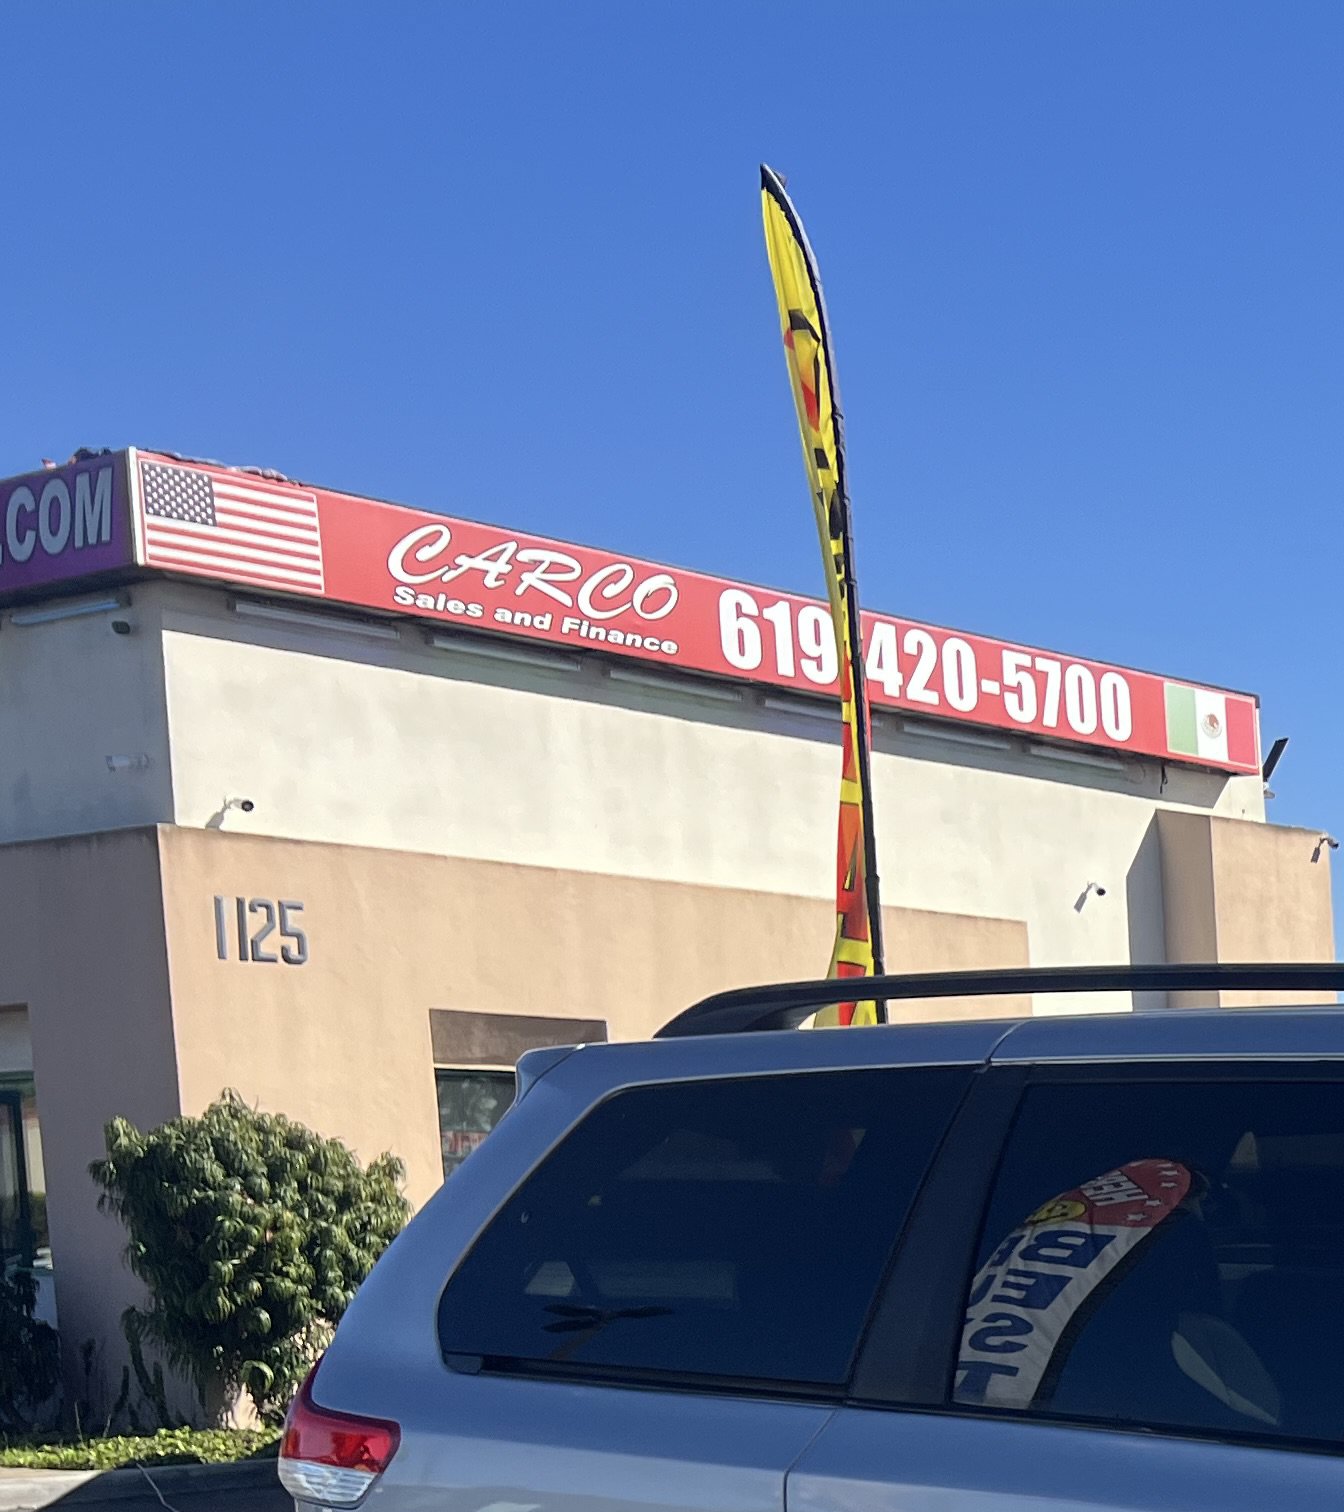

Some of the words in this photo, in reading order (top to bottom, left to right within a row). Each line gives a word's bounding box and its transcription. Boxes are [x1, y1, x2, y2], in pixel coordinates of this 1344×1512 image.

[0, 466, 113, 565] COM
[387, 523, 679, 620] CARCO
[393, 585, 485, 619] Sales
[493, 606, 553, 632] and
[560, 616, 680, 655] Finance
[718, 588, 839, 685] 619
[865, 622, 1132, 742] 420-5700
[212, 895, 309, 966] 1125
